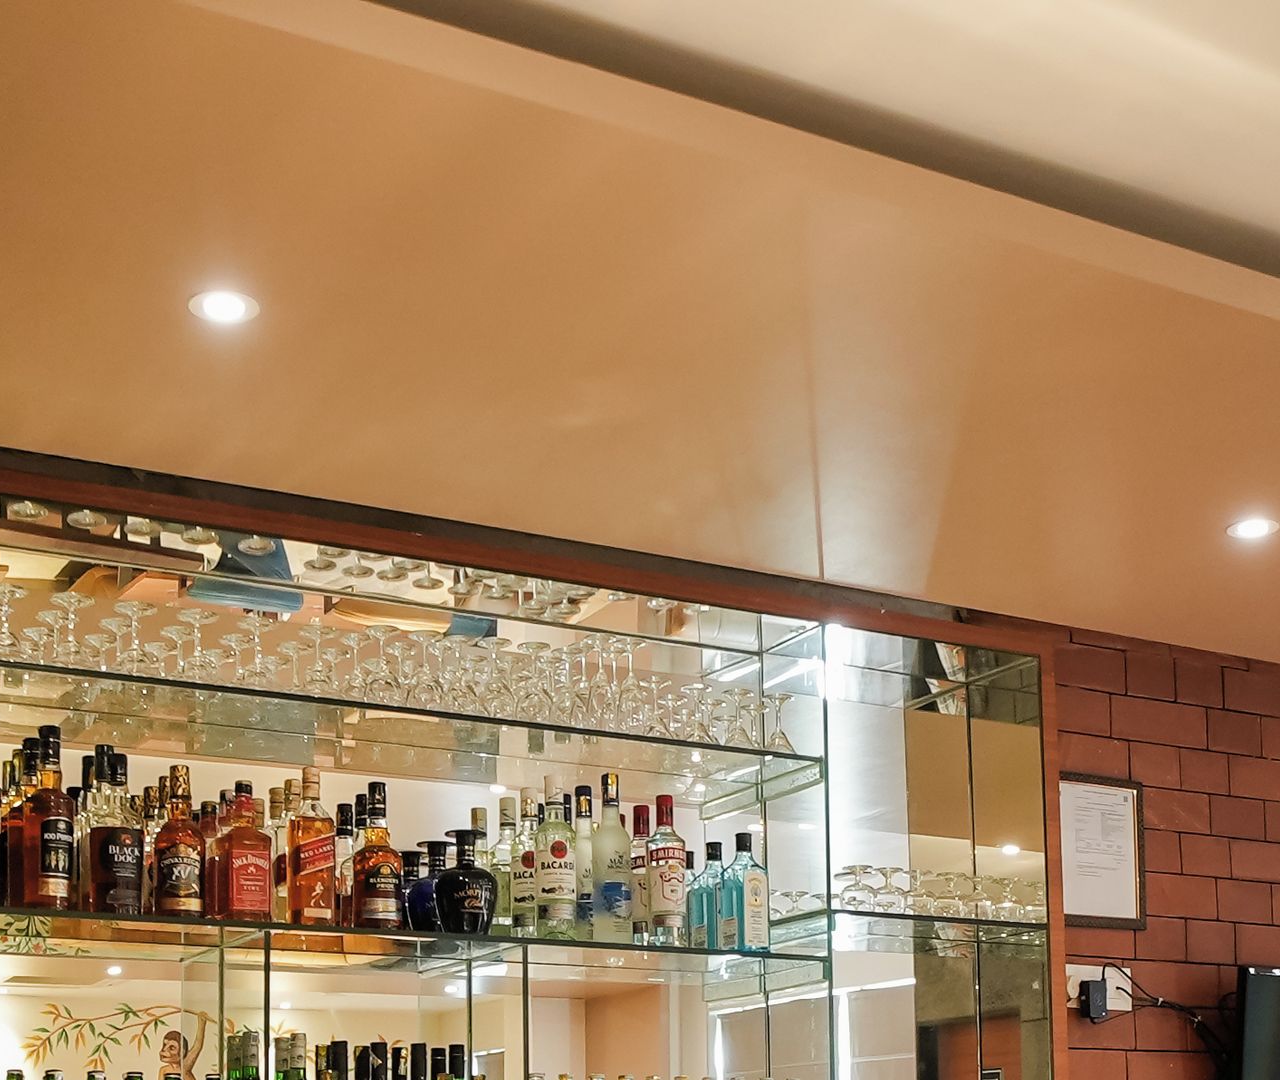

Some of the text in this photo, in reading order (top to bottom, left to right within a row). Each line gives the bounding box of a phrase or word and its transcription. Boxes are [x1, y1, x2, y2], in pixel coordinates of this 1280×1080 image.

[108, 844, 140, 857] BLACK
[300, 850, 314, 859] RED
[114, 854, 137, 863] DOG
[171, 866, 191, 880] XV
